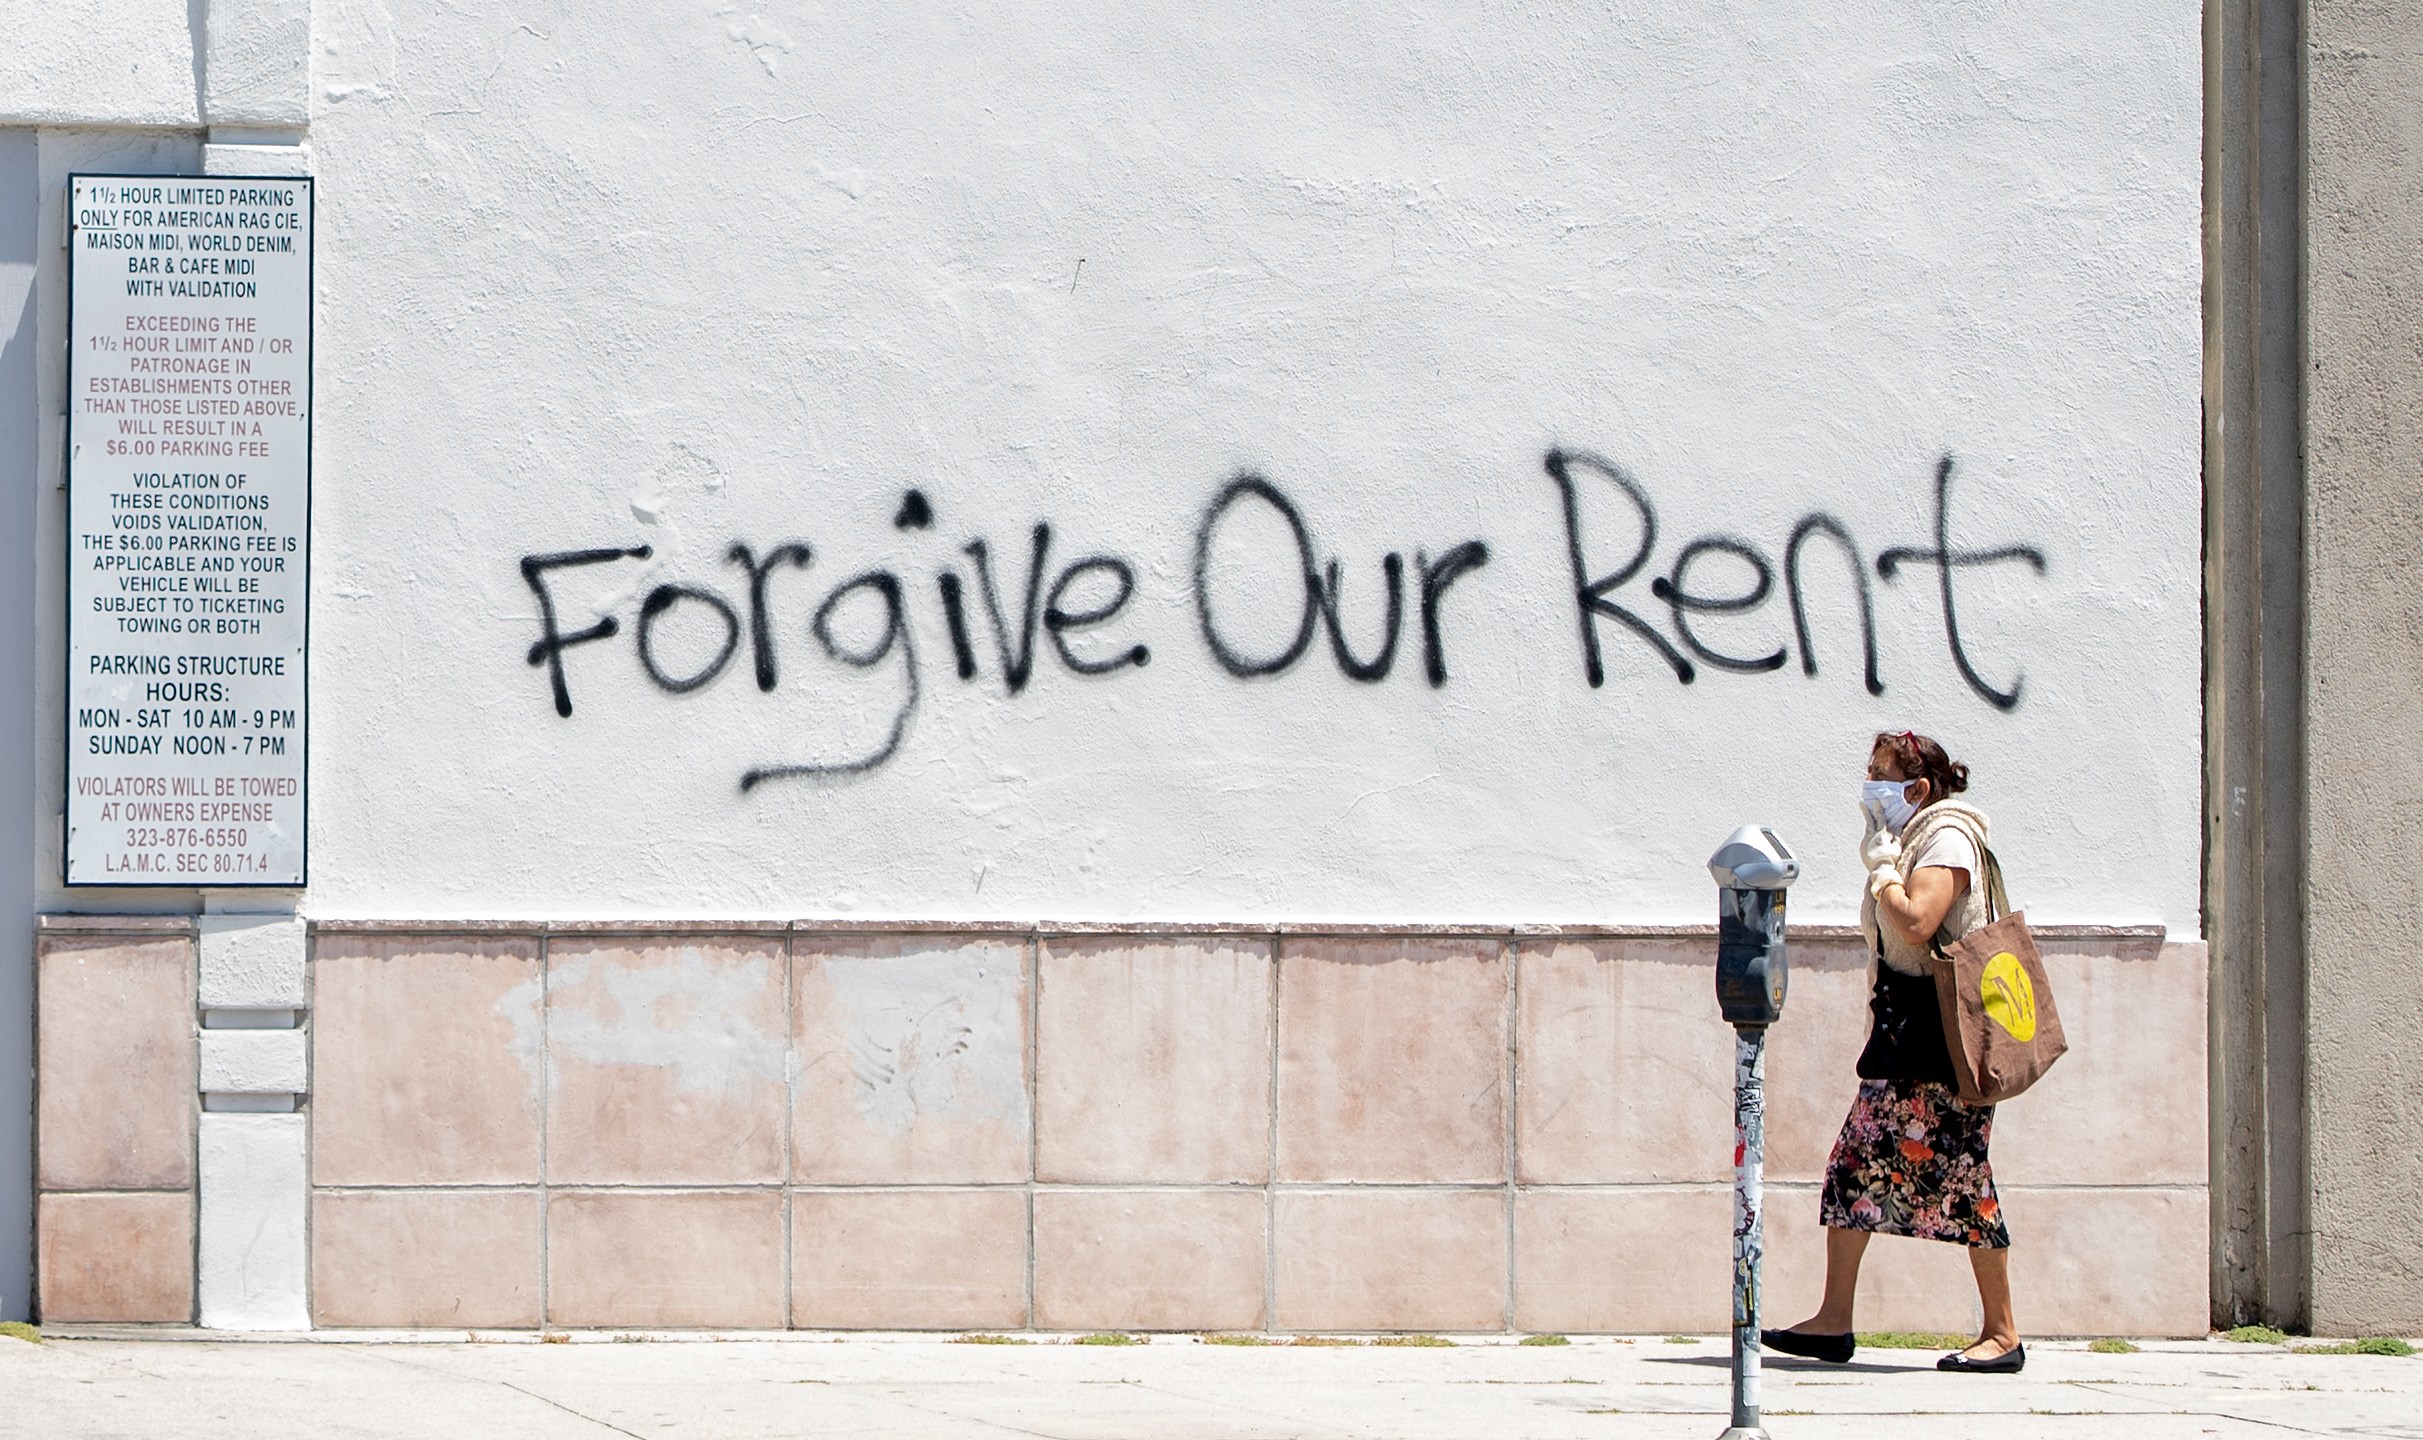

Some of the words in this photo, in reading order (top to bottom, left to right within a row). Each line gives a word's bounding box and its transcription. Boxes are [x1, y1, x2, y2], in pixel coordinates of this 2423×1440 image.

[120, 187, 162, 205] HOUR
[167, 188, 225, 205] LIMITED
[230, 189, 294, 206] PARKING
[81, 209, 119, 227] ONLY
[123, 210, 153, 227] FOR
[157, 211, 234, 229] AMERICAN
[239, 213, 270, 229] RAG
[275, 213, 303, 232] CIE,
[87, 233, 144, 250] MAISON
[149, 234, 184, 253] MIDI,
[187, 235, 242, 252] WORLD
[246, 236, 296, 255] DENIM,
[129, 257, 160, 274] BAR
[165, 258, 175, 274] &
[180, 259, 219, 275] CAFE
[224, 260, 255, 275] MIDI
[127, 280, 163, 297] WITH
[169, 281, 256, 298] VALIDATION
[126, 316, 220, 333] EXCEEDING
[225, 318, 257, 333] THE
[123, 337, 170, 353] HOUR
[175, 338, 217, 353] LIMIT
[221, 338, 254, 354] AND
[270, 339, 292, 354] OR
[130, 357, 230, 374] PATRONAGE
[235, 359, 251, 374] IN
[90, 378, 232, 395] ESTABLISHMENTS
[237, 380, 292, 396] OTHER
[83, 398, 126, 414] THAN
[131, 399, 182, 414] THOSE
[186, 400, 240, 416] LISTED
[244, 401, 296, 416] ABOVE
[118, 419, 157, 435] WILL
[163, 420, 226, 436] RESULT
[231, 421, 247, 436] IN
[251, 422, 262, 436] A
[106, 439, 156, 457] $6.00
[161, 441, 233, 457] PARKING
[238, 442, 269, 457] FEE
[133, 473, 220, 489] VIOLATION
[225, 474, 247, 489] OF
[110, 494, 163, 509] THESE
[169, 495, 270, 510] CONDITIONS
[112, 514, 162, 530] VOIDS
[167, 515, 268, 533] VALIDATION,
[82, 534, 114, 550] THE
[119, 535, 163, 552] $6.00
[168, 536, 241, 551] PARKING
[246, 536, 277, 552] FEE
[282, 537, 297, 552] IS
[93, 556, 196, 572] APPLICABLE
[200, 557, 235, 572] AND
[240, 557, 285, 573] YOUR
[119, 576, 188, 592] VEHICLE
[193, 577, 232, 593] WILL
[238, 578, 259, 593] BE
[93, 597, 167, 613] SUBJECT
[172, 598, 194, 613] TO
[199, 598, 285, 614] TICKETING
[117, 618, 182, 633] TOWING
[187, 618, 211, 634] OR
[217, 619, 261, 634] BOTH
[519, 488, 1151, 794] Forgive
[1196, 471, 1490, 689] Our
[1544, 450, 2047, 712] Rent
[90, 655, 171, 675] PARKING
[177, 656, 285, 675] STRUCTURE
[146, 682, 230, 702] HOURS:
[79, 709, 120, 728] MON
[137, 709, 171, 728] SAT
[183, 709, 204, 729] 10
[209, 709, 237, 729] AM
[253, 710, 264, 729] 9
[270, 710, 296, 729] PM
[89, 735, 162, 755] SUNDAY
[173, 736, 226, 755] NOON
[243, 737, 253, 755] 7
[259, 737, 286, 755] PM
[77, 777, 167, 796] VIOLATORS
[172, 778, 210, 796] WILL
[214, 778, 236, 796] BE
[240, 778, 297, 797] TOWED
[101, 802, 121, 821] AT
[125, 803, 195, 822] OWNERS
[200, 803, 273, 822] EXPENSE
[126, 828, 247, 847] 323-876-6550
[106, 853, 171, 872] L.A.M.C.
[176, 854, 208, 872] SEC
